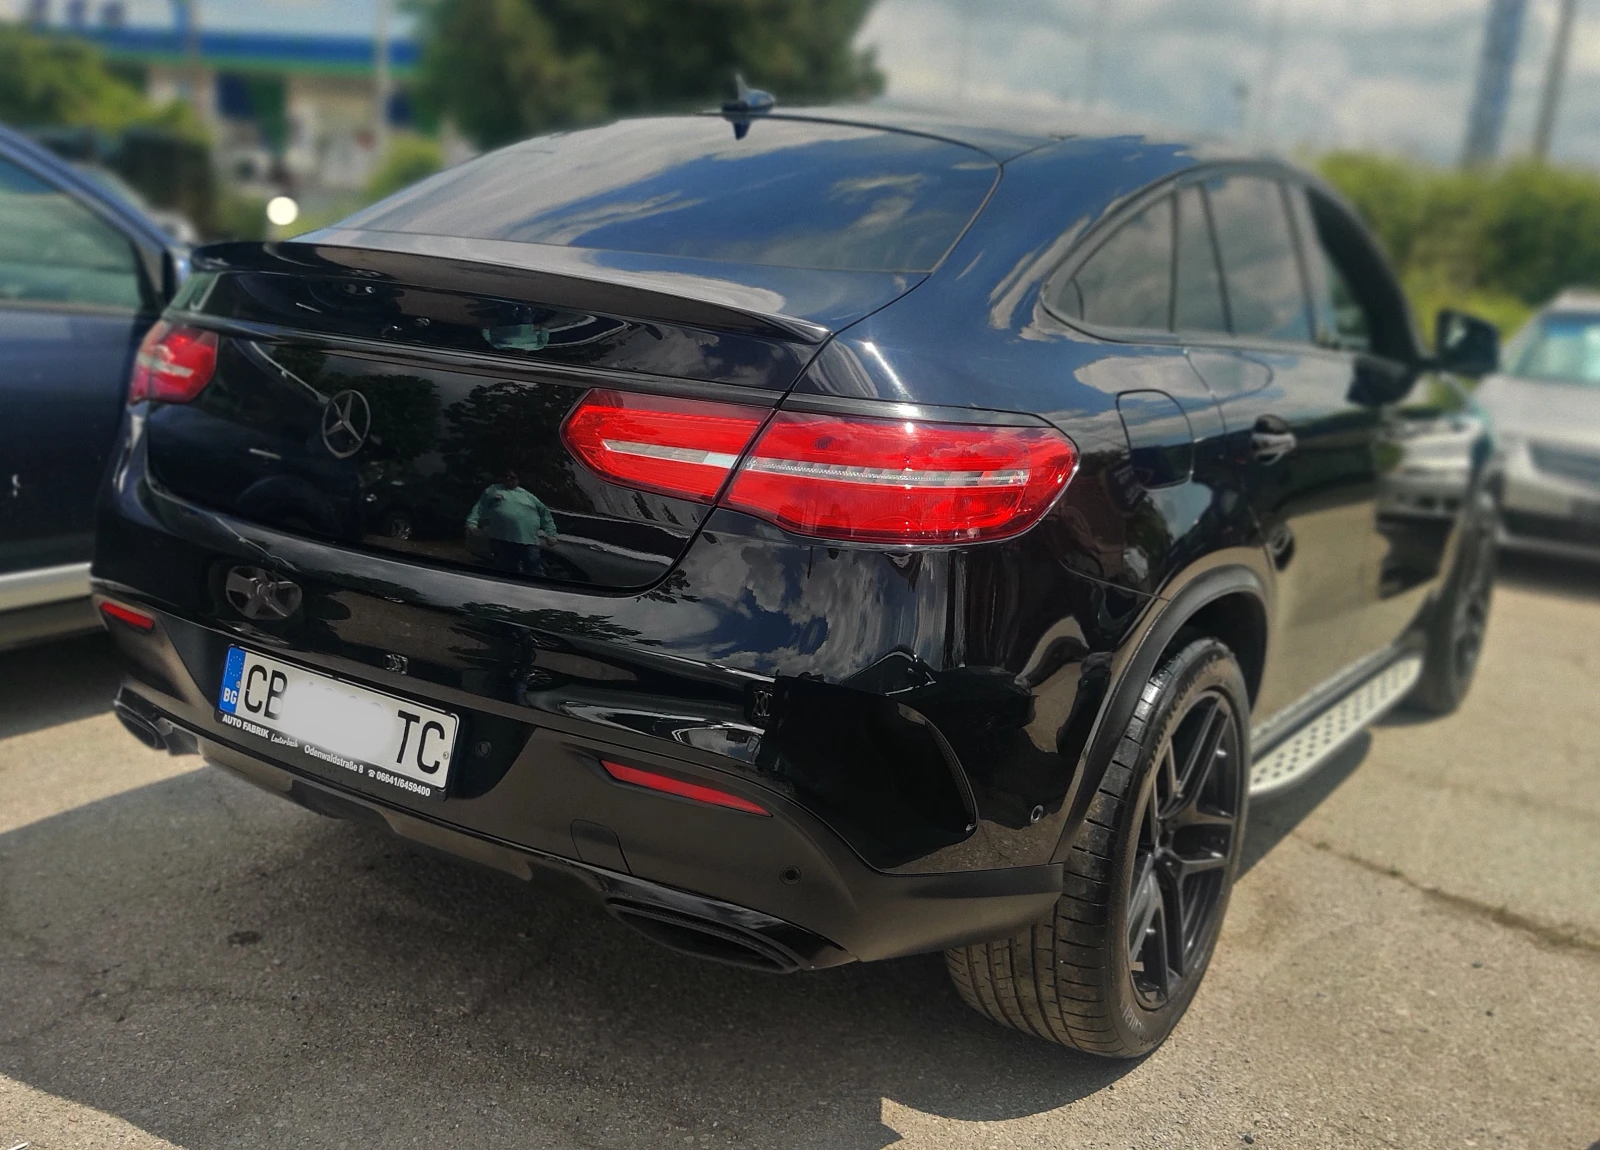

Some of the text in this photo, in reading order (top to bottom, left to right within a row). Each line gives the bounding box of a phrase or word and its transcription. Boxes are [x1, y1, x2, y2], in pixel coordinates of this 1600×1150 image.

[222, 687, 237, 704] BG
[222, 714, 242, 728] AUTO
[242, 721, 270, 739] FABRIK
[396, 710, 446, 775] TC
[304, 744, 431, 797] Odenwaldstraße 8 06641/6459400
